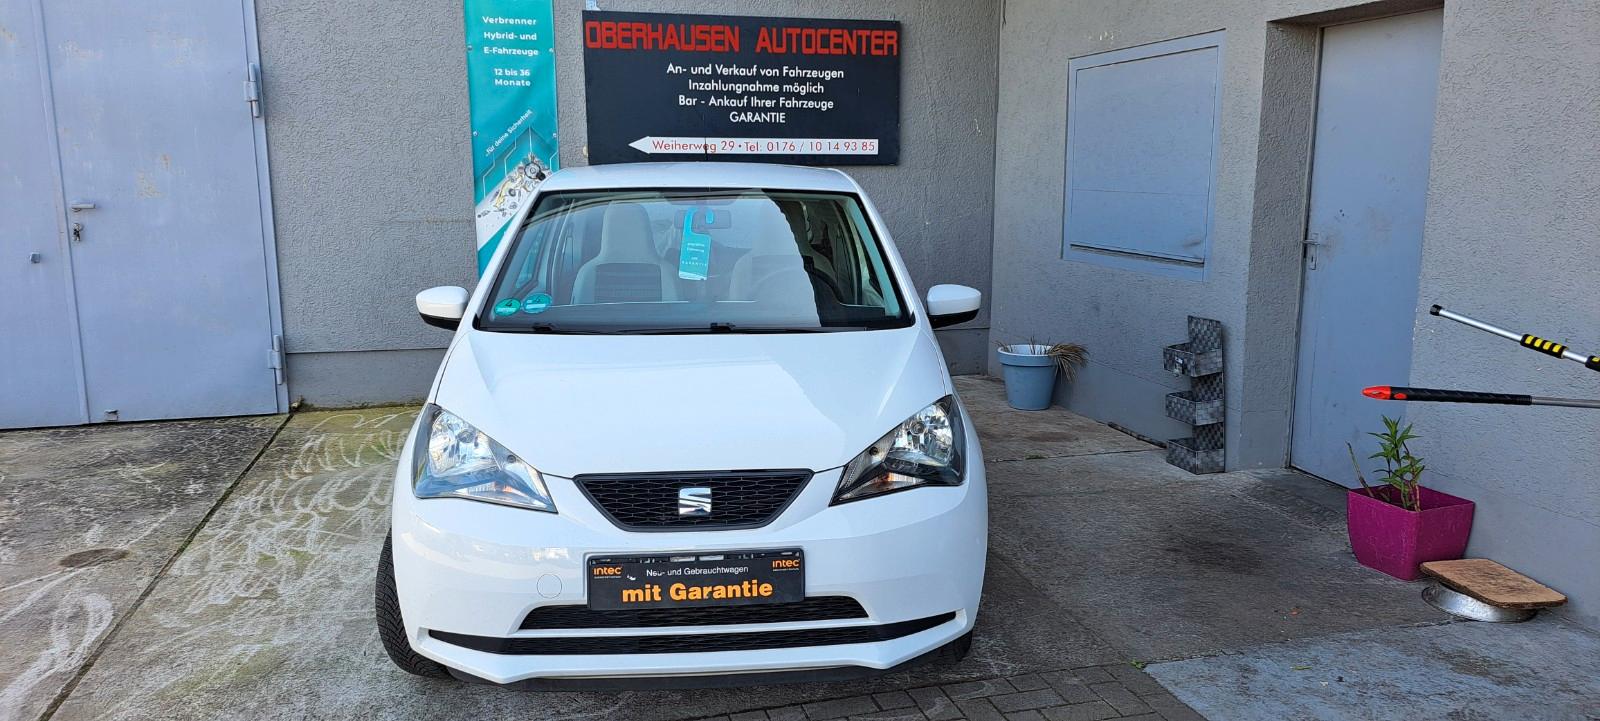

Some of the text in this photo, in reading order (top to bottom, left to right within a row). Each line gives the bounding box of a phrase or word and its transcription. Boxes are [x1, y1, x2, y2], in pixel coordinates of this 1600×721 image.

[482, 16, 537, 25] Verbrenner
[483, 32, 518, 40] Hybrid-
[585, 21, 898, 56] OBERHAUSEN AUTOCENTER
[483, 47, 539, 57] E-Fahrzeuge
[494, 68, 503, 76] 12
[666, 62, 844, 80] An- und Verkauf von Fahrzeugen
[495, 79, 531, 87] Monate
[688, 79, 824, 96] Inzahlungnahme möglich
[678, 95, 697, 106] Bar
[708, 96, 748, 107] Ankauf
[751, 97, 776, 108] Ihrer
[780, 97, 834, 112] Fahrzeuge
[729, 111, 786, 123] GARANTIE
[652, 140, 717, 153] Weiherweg
[721, 140, 735, 151] 29
[766, 141, 796, 152] 0176
[810, 141, 822, 152] 10
[827, 141, 840, 152] 14
[844, 141, 858, 152] 93
[861, 141, 875, 152] 85
[772, 559, 800, 568] intec
[593, 566, 622, 575] intec
[667, 567, 682, 576] und
[683, 565, 749, 576] Gebrauchtwagen
[622, 579, 774, 603] mit Garantie
